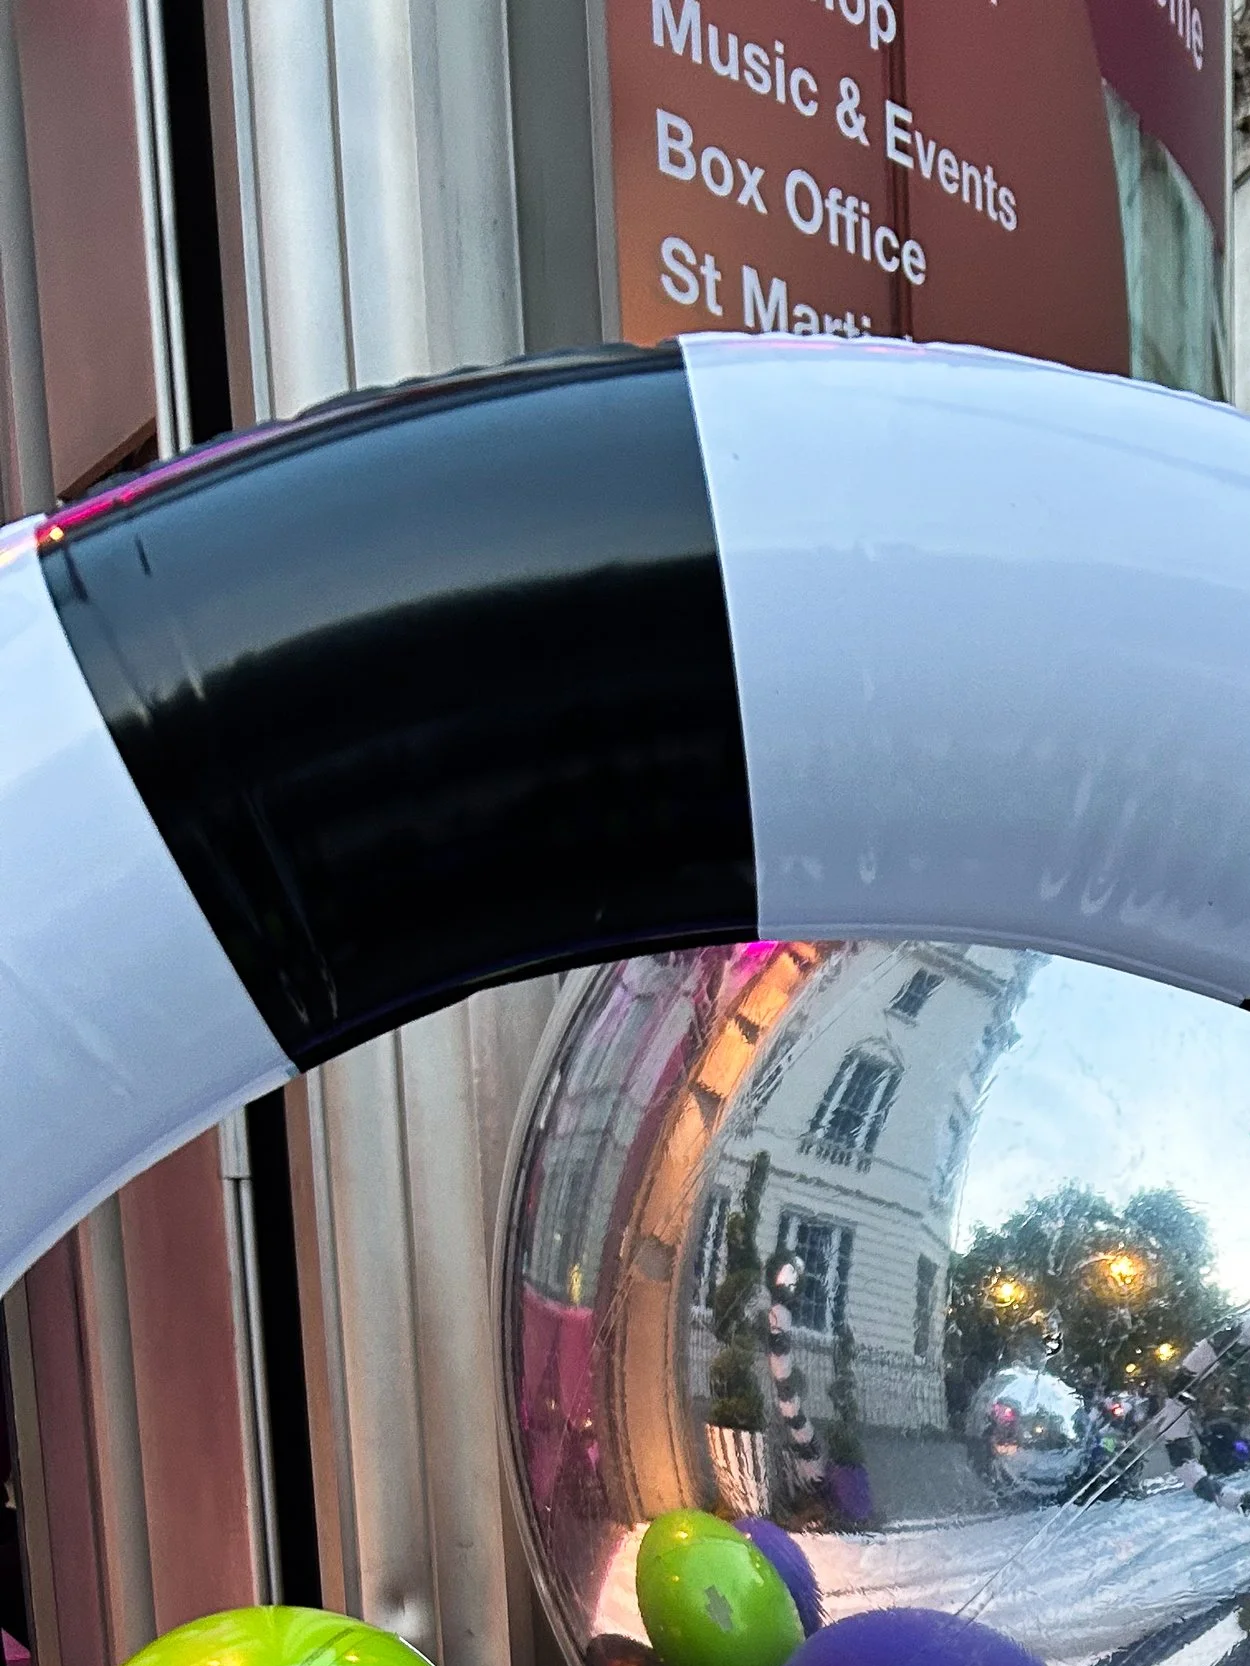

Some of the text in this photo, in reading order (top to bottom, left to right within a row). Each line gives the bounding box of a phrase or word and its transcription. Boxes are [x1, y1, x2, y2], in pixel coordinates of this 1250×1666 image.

[652, 0, 1018, 232] Music & Events
[656, 108, 927, 285] Box Office
[660, 236, 723, 317] St
